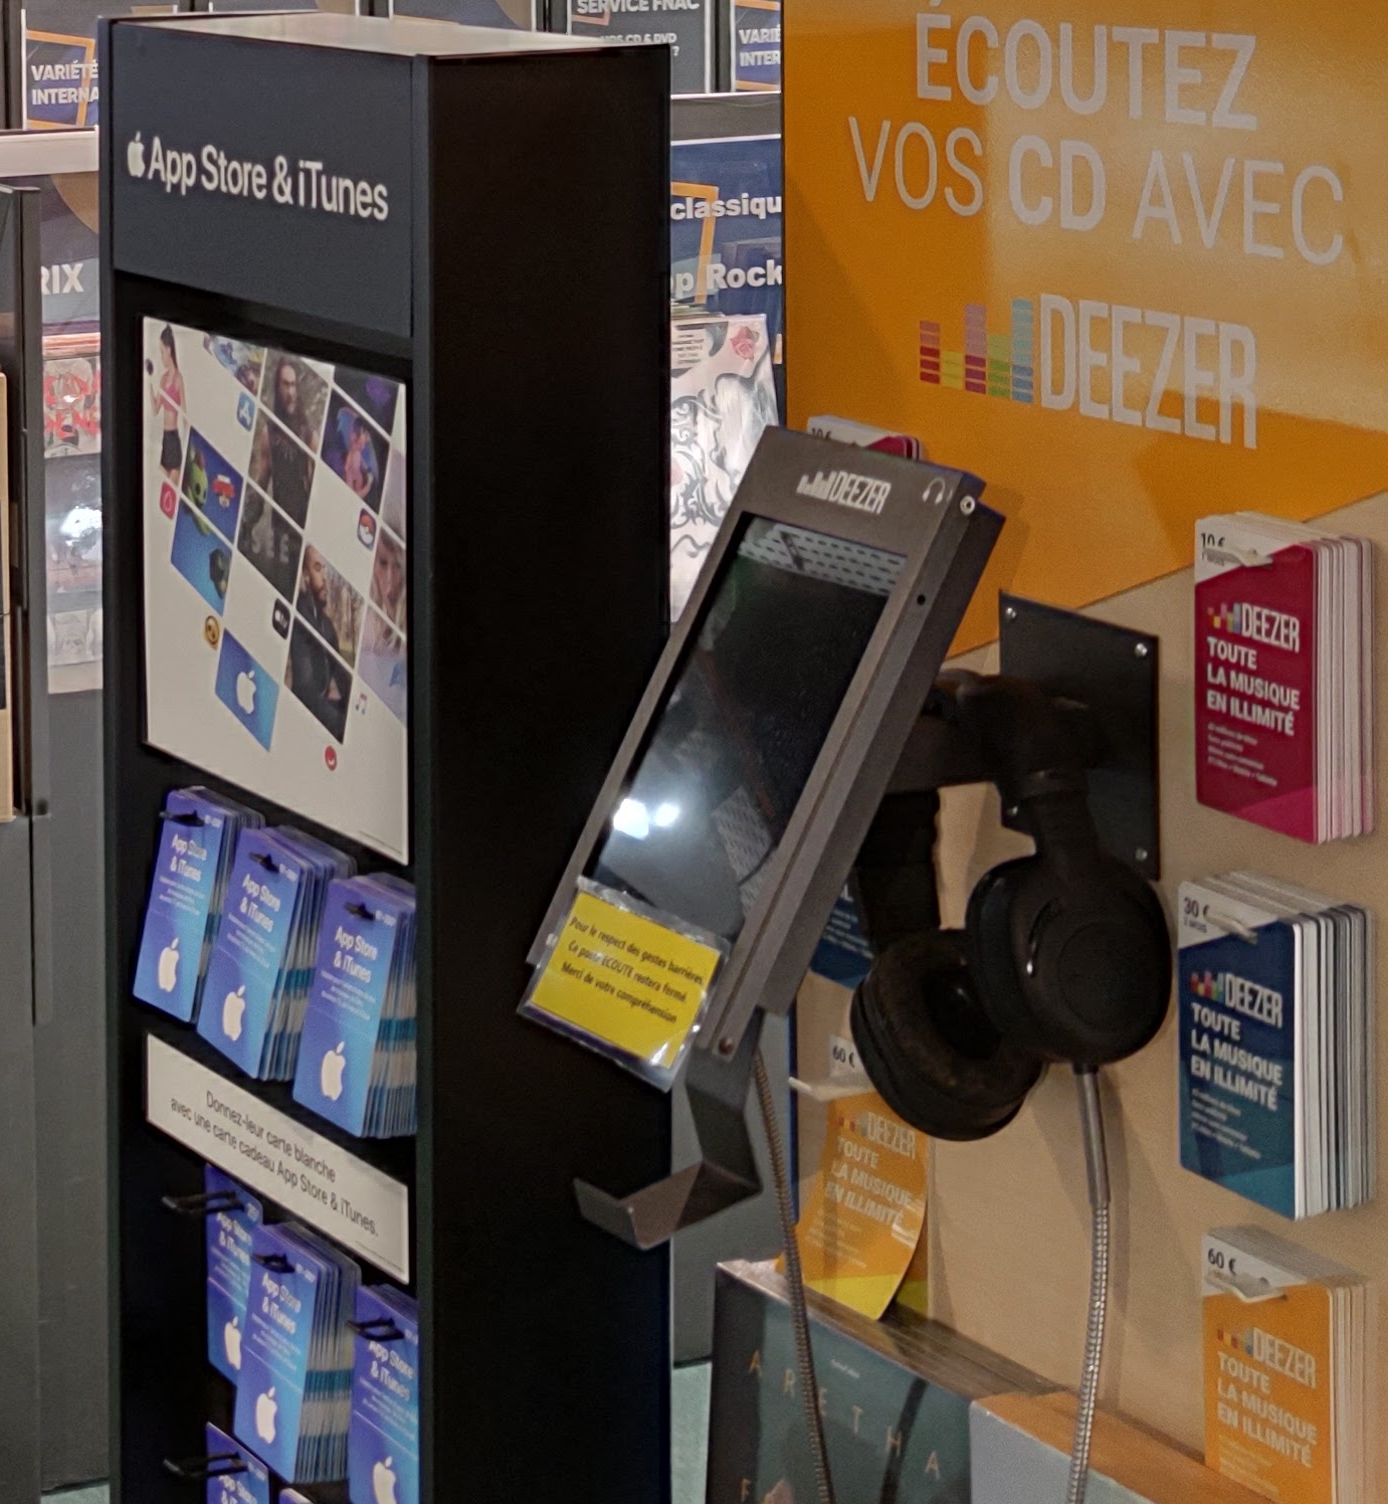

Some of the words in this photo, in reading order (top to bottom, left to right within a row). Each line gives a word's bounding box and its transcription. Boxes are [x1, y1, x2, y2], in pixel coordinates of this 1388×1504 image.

[32, 58, 99, 82] VARIÉTÉ
[148, 136, 196, 195] App
[200, 144, 267, 200] Store
[272, 154, 293, 204] &
[297, 159, 389, 221] iTunes
[848, 115, 984, 217] VOS
[1007, 134, 1106, 231] CD
[1131, 149, 1344, 267] AVEC
[706, 258, 782, 289] Rock
[1040, 293, 1257, 450] DEEZER
[827, 470, 891, 515] DEEZER
[1241, 602, 1301, 654] DEEZER
[1206, 635, 1257, 670] TOUTE
[1207, 662, 1228, 687] LA
[1229, 668, 1301, 711] MUSIQUE
[1206, 689, 1228, 714] EN
[1229, 696, 1296, 737] ILLIMITÉ
[241, 872, 260, 899] App
[259, 884, 282, 914] Store
[1183, 896, 1200, 919] 30
[334, 924, 354, 952] App
[353, 933, 379, 962] Store
[568, 915, 590, 934] Pour
[598, 930, 627, 952] respect
[626, 942, 640, 958] des
[640, 949, 668, 970] gestes
[342, 953, 372, 985] iTunes
[561, 961, 584, 981] Merci
[583, 971, 595, 986] de
[594, 976, 617, 996] votre
[615, 988, 678, 1025] compréhension
[633, 970, 662, 993] restera
[1190, 1002, 1241, 1043] TOUTE
[1223, 971, 1284, 1030] DEEZER
[832, 1047, 847, 1065] 60
[1190, 1029, 1211, 1055] LA
[1213, 1037, 1284, 1087] MUSIQUE
[1190, 1055, 1212, 1082] EN
[1213, 1065, 1279, 1113] ILLIMITÉ
[205, 1089, 265, 1140] Donnez-leur
[265, 1129, 294, 1158] carte
[293, 1141, 337, 1184] blanche
[170, 1097, 192, 1122] avec
[192, 1111, 212, 1134] une
[212, 1124, 238, 1151] carte
[238, 1139, 277, 1176] cadeau
[276, 1160, 299, 1190] App
[299, 1173, 328, 1205] Store
[329, 1192, 340, 1212] &
[340, 1197, 380, 1238] iTunes.
[1207, 1247, 1225, 1271] 60
[1216, 1349, 1271, 1395] TOUTE
[1217, 1376, 1238, 1404] LA
[1241, 1389, 1318, 1446] MUSIQUE
[1217, 1400, 1240, 1430] EN
[1242, 1416, 1313, 1470] ILLIMITÉ
